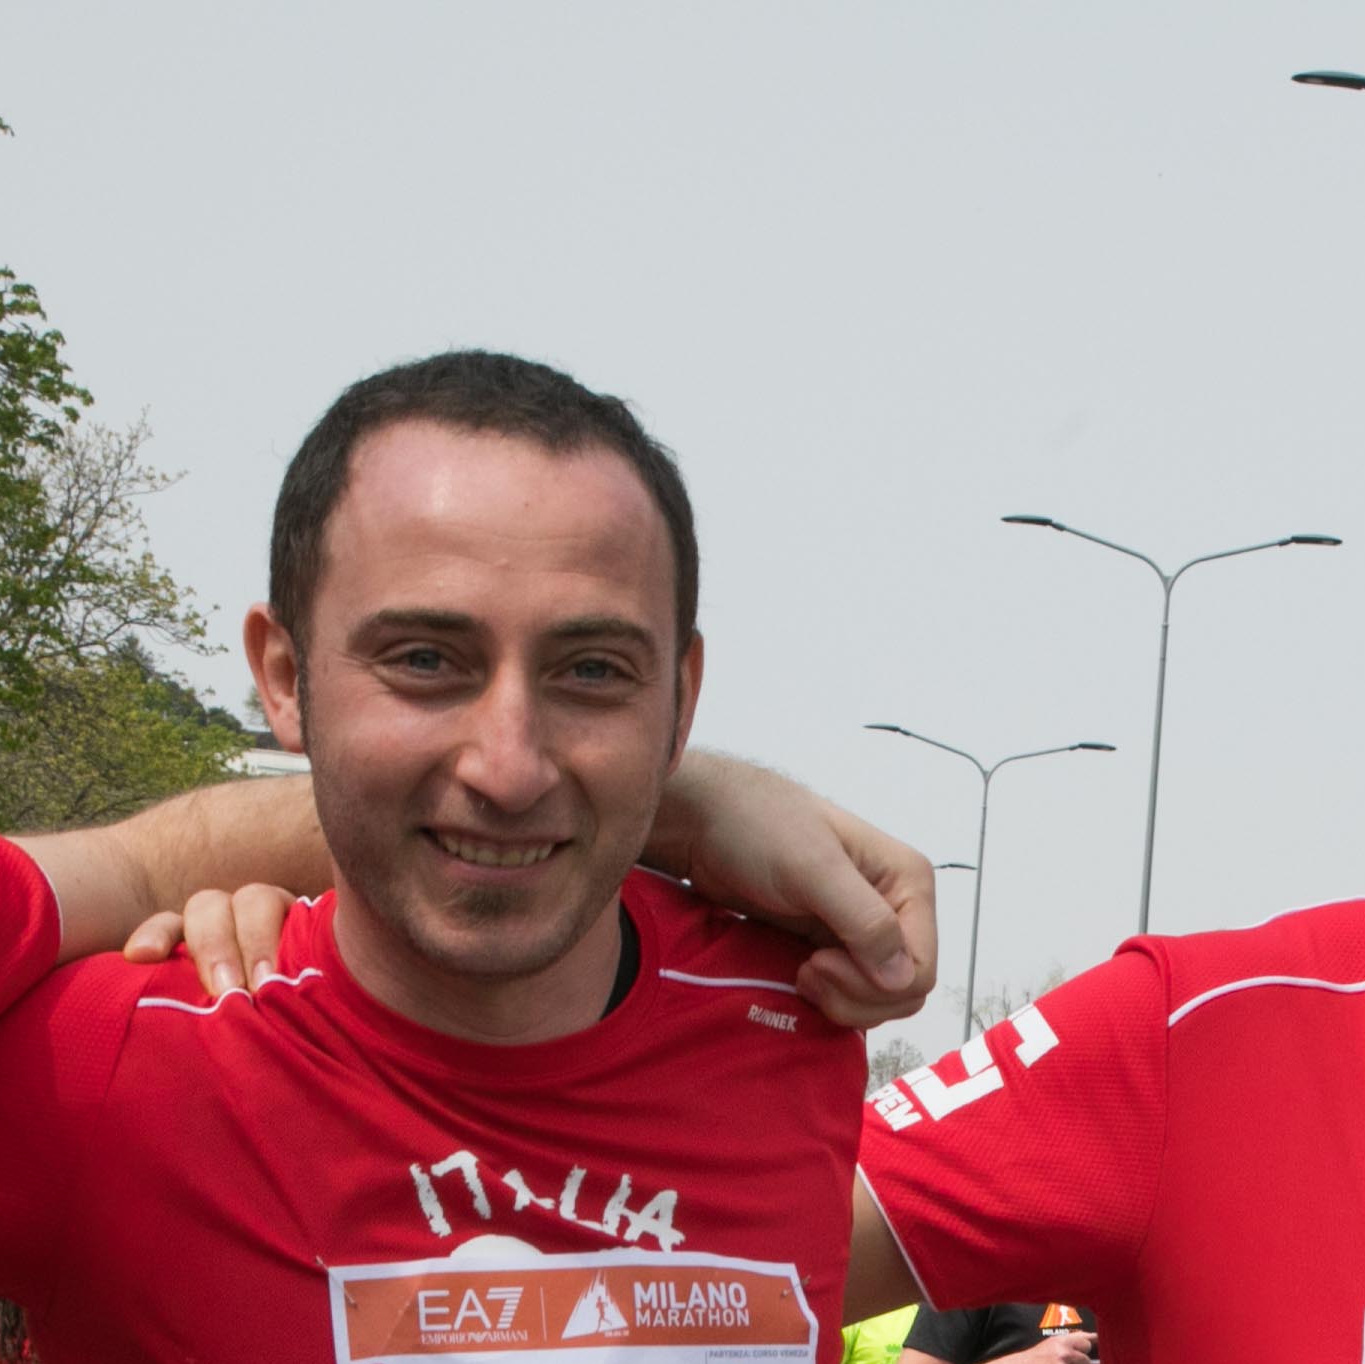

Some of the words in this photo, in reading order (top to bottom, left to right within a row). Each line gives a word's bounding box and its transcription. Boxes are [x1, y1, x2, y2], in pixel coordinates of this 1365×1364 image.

[747, 1004, 798, 1032] RUNNEK
[417, 1287, 523, 1331] EA7
[634, 1282, 747, 1310] MILANO
[636, 1308, 750, 1328] MARATHON
[485, 1330, 528, 1342] ARMANI
